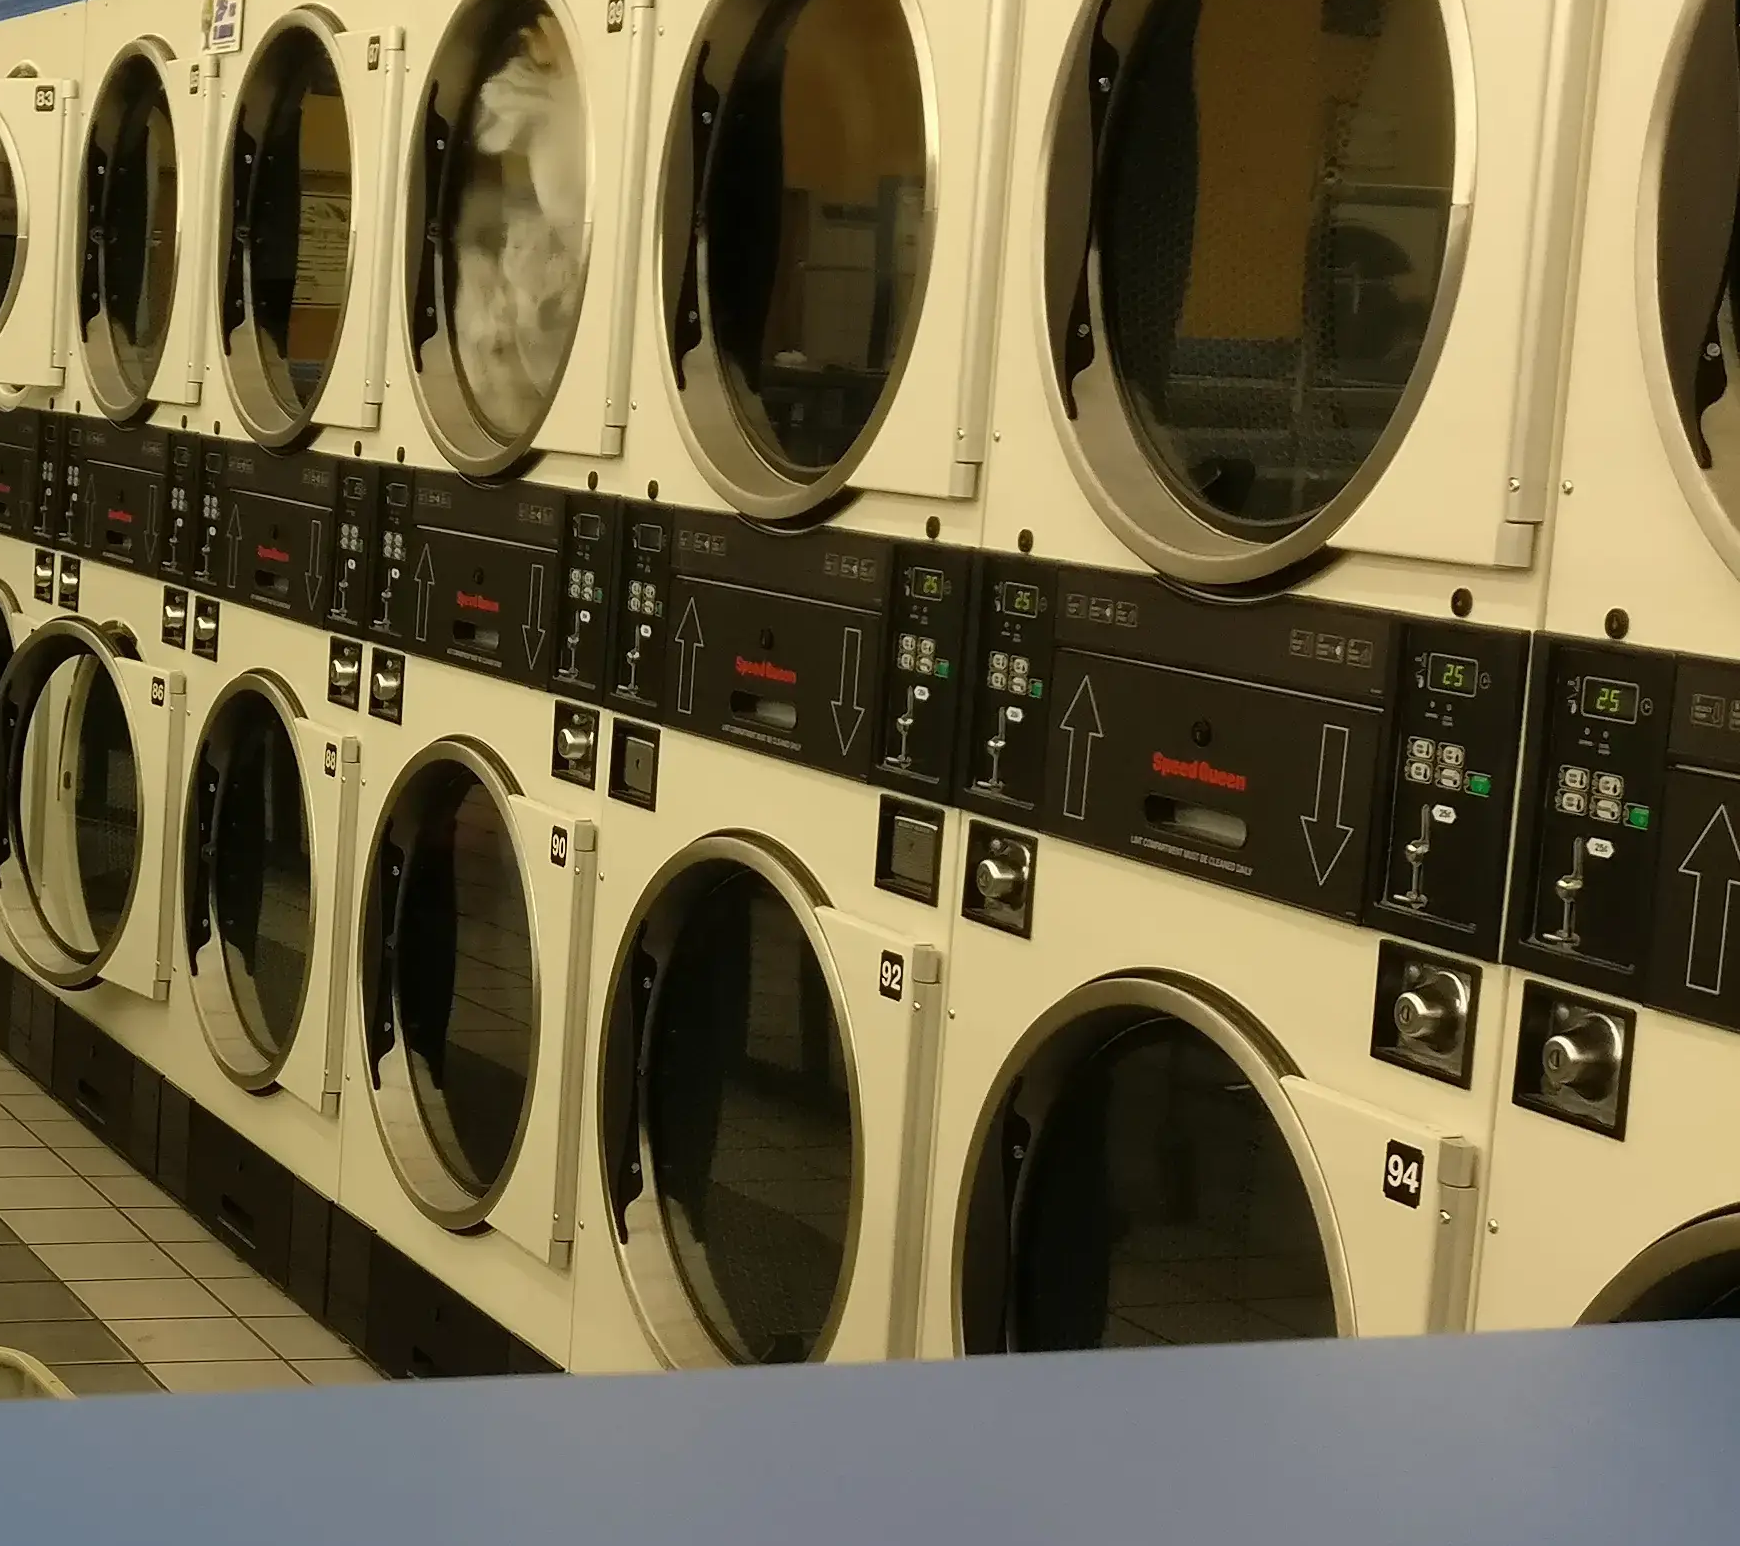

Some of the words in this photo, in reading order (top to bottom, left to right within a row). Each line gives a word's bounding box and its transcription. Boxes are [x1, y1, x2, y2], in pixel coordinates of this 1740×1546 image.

[608, 1, 623, 24] 89
[36, 91, 54, 106] 83
[1442, 664, 1466, 687] 25
[153, 683, 164, 700] 86
[1596, 688, 1622, 712] 25
[326, 749, 336, 770] 88
[1153, 751, 1198, 780] Speed
[1198, 761, 1247, 791] Queen
[552, 833, 566, 858] 90
[881, 960, 901, 991] 92
[1387, 1153, 1420, 1193] 94
